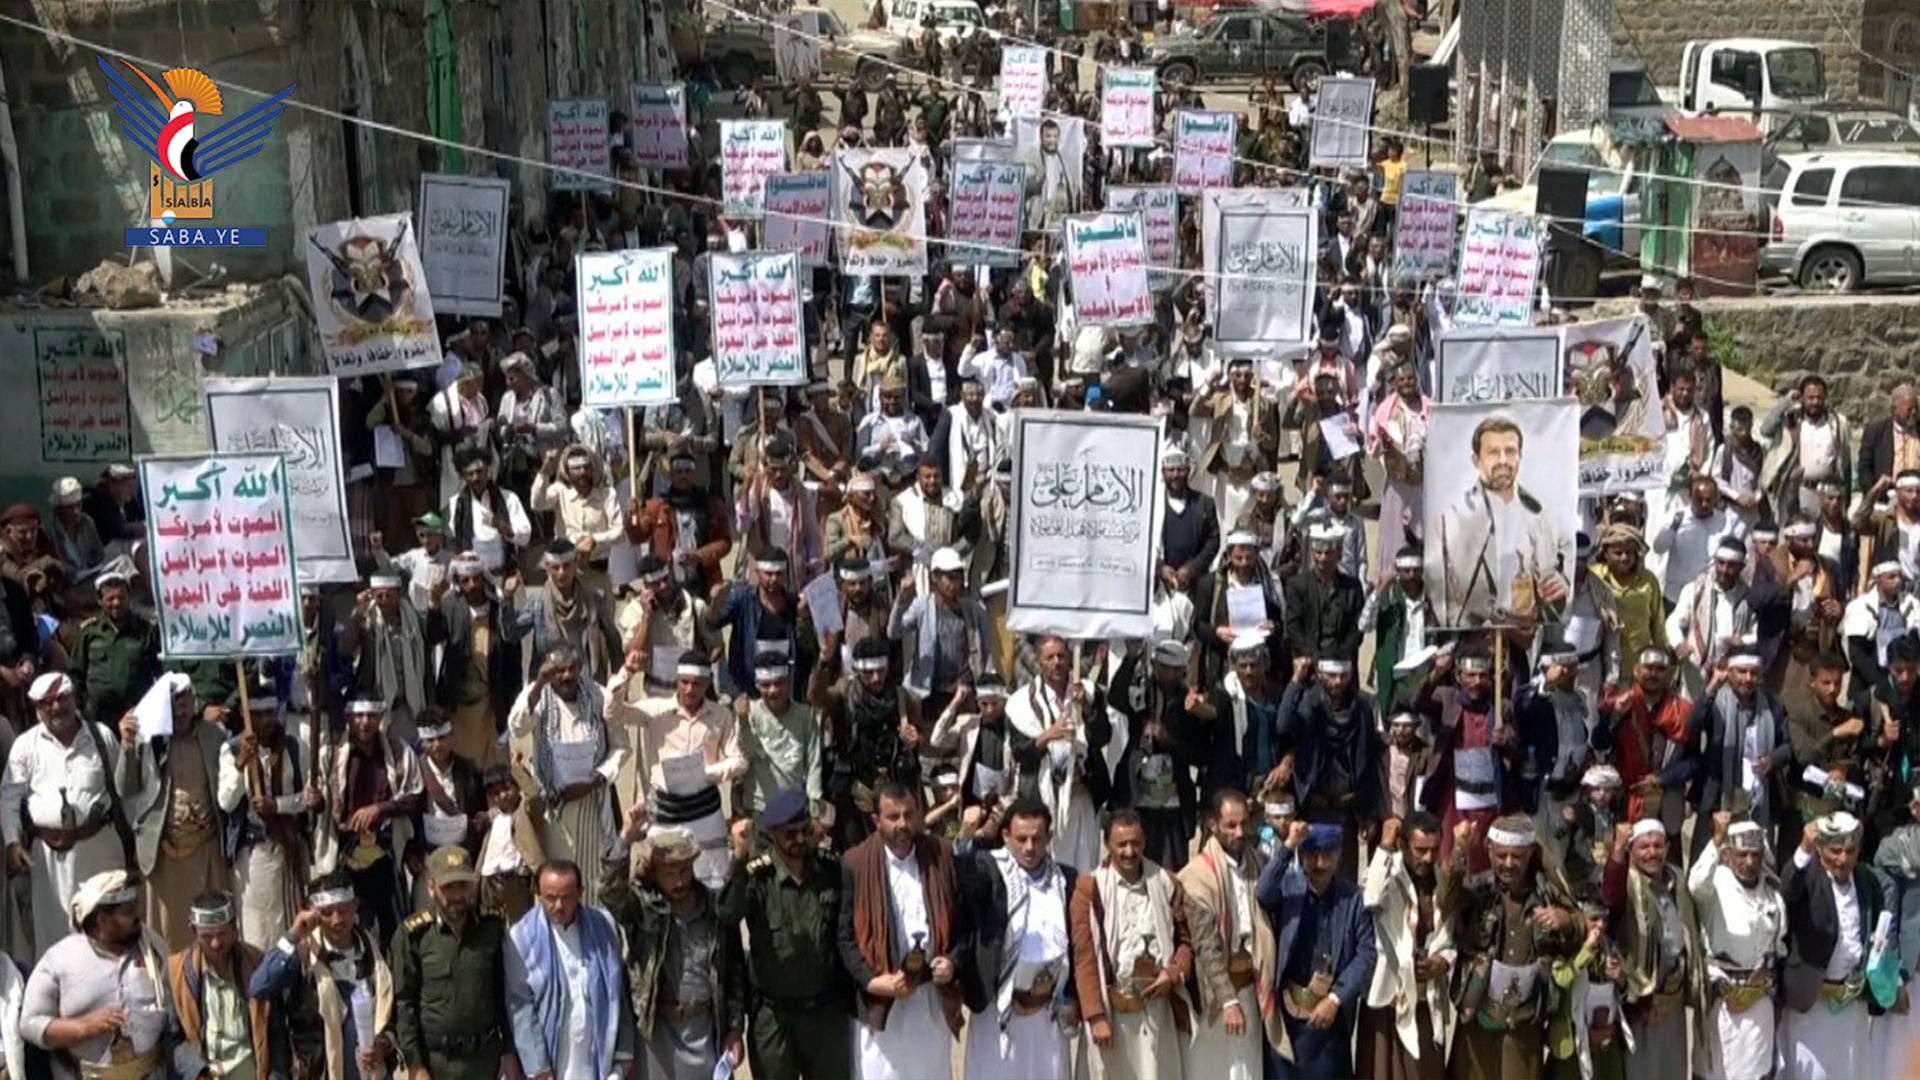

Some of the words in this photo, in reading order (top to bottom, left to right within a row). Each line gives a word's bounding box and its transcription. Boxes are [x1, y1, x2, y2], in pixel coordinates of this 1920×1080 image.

[586, 258, 635, 294] أكبر
[638, 260, 666, 283] الله
[717, 256, 760, 288] أكبر
[766, 258, 795, 280] الله
[632, 293, 667, 314] الموت
[761, 287, 797, 305] الموت
[632, 320, 667, 338] الموت
[761, 310, 797, 328] الموت
[719, 334, 748, 352] اليهود
[751, 335, 768, 351] على
[772, 332, 799, 348] اللعنة
[587, 347, 618, 368] اليهود
[621, 347, 637, 367] على
[641, 344, 668, 361] اللعنة
[765, 350, 801, 377] النصر
[633, 366, 669, 396] النصر
[155, 461, 227, 512] أكبر
[232, 465, 280, 499] الله
[228, 509, 283, 538] الموت
[231, 545, 286, 574] الموت
[164, 580, 211, 611] اليهود
[216, 582, 241, 608] على
[247, 576, 290, 602] اللعنة
[240, 608, 293, 646] النصر
